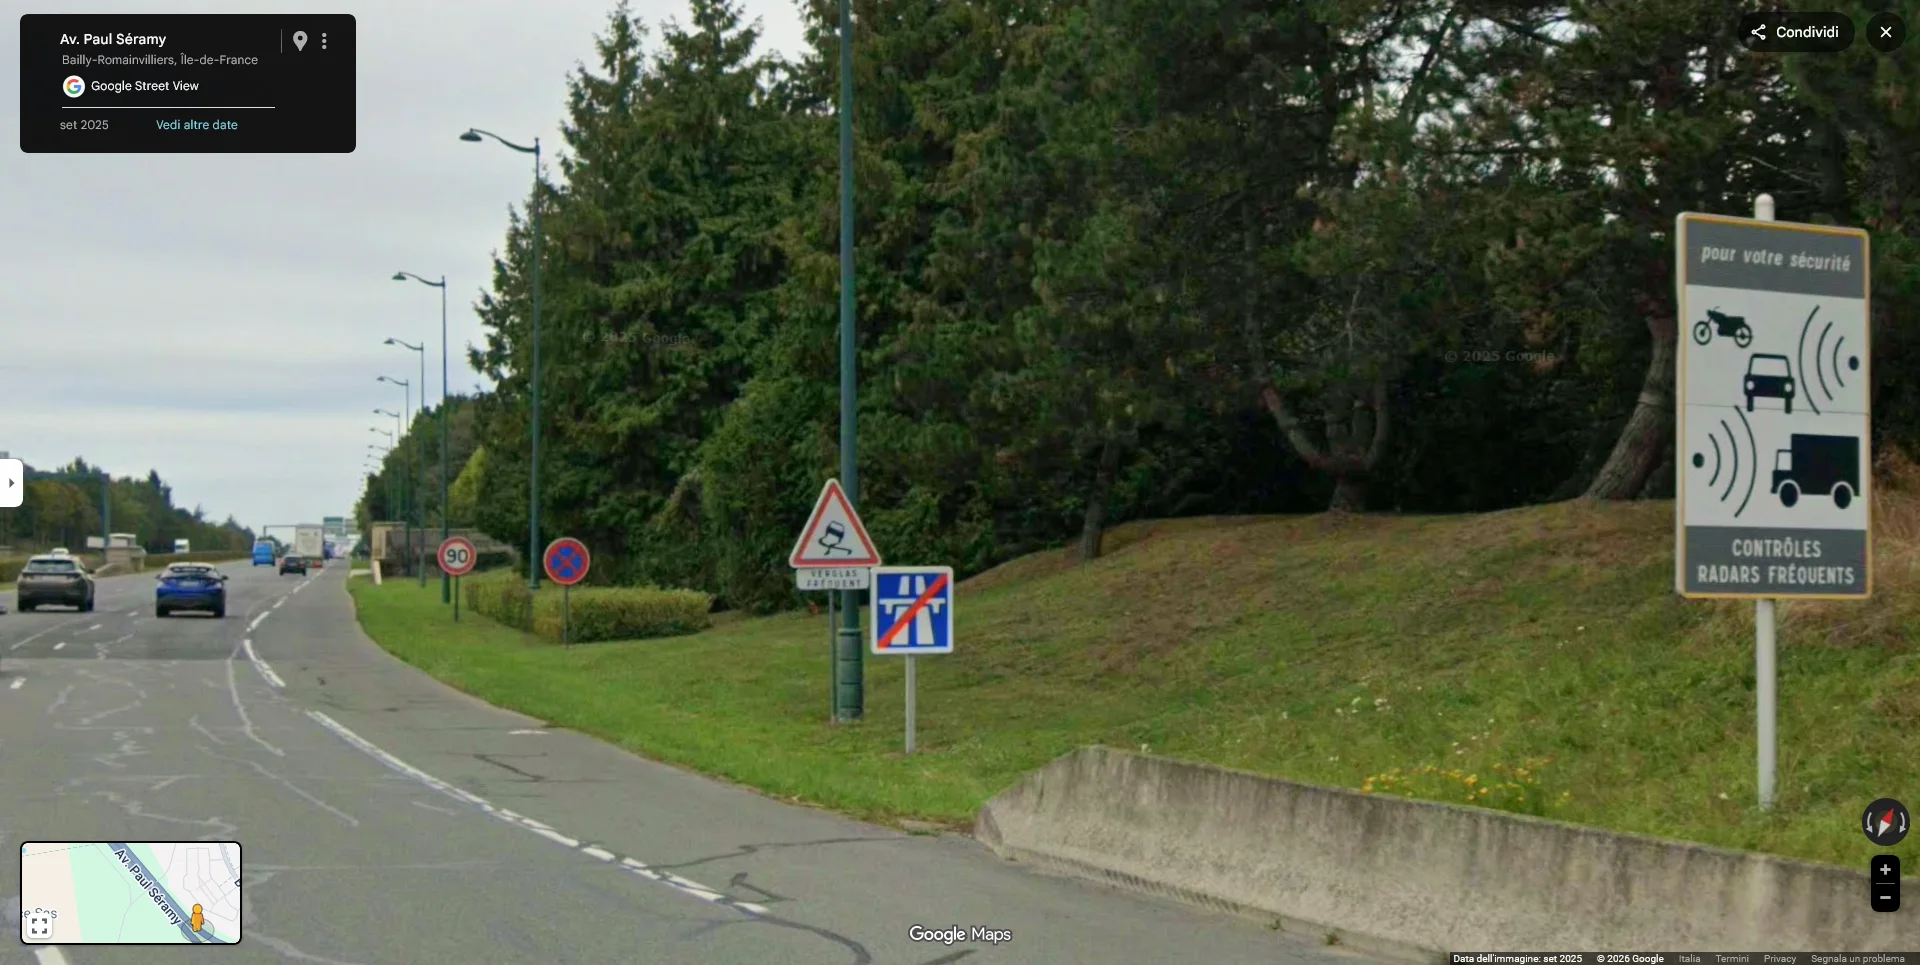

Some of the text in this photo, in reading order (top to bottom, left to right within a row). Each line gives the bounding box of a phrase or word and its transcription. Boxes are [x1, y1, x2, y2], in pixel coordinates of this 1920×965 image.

[1701, 246, 1851, 272] pour votre sécurité
[447, 549, 468, 564] 90
[1732, 536, 1822, 558] CONTRÔLES
[1697, 563, 1855, 584] RADARS FRÉQUENTS
